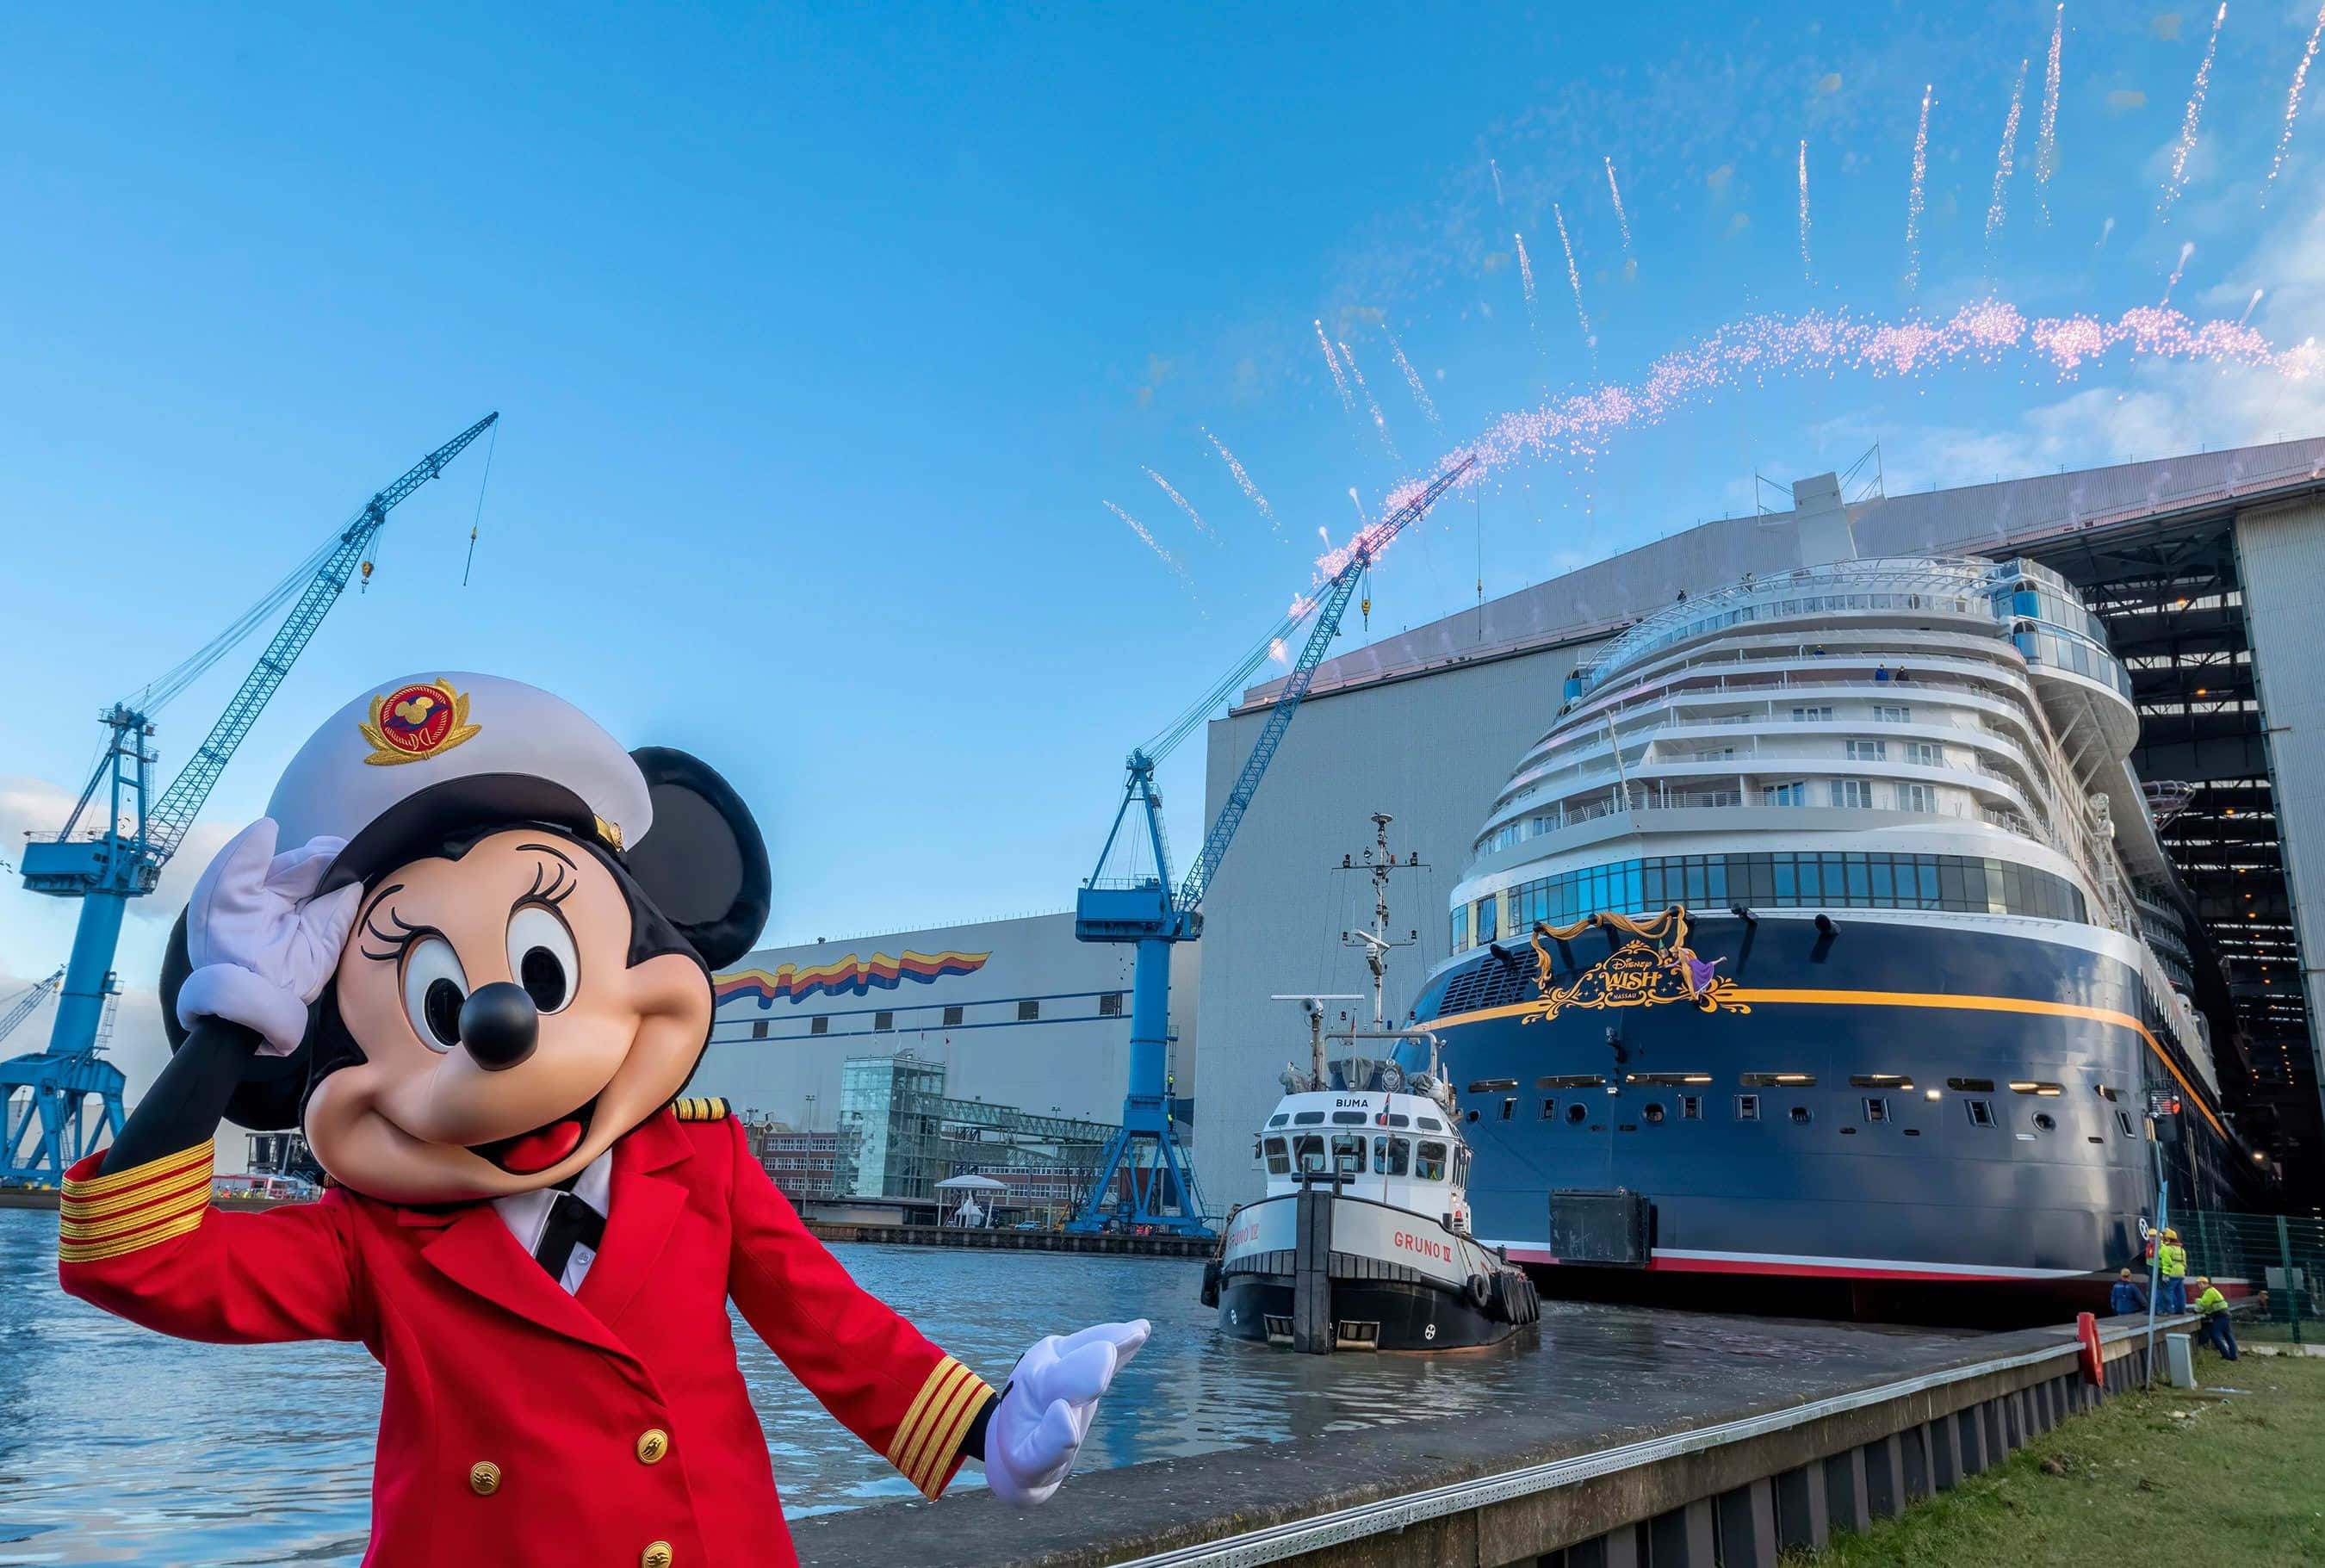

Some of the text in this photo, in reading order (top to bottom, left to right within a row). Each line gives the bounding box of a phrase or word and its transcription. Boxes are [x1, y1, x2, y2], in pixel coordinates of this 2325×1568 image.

[1598, 970, 1663, 992] WISH
[1336, 1099, 1369, 1108] BIJMA
[1394, 1230, 1441, 1259] GRUNO
